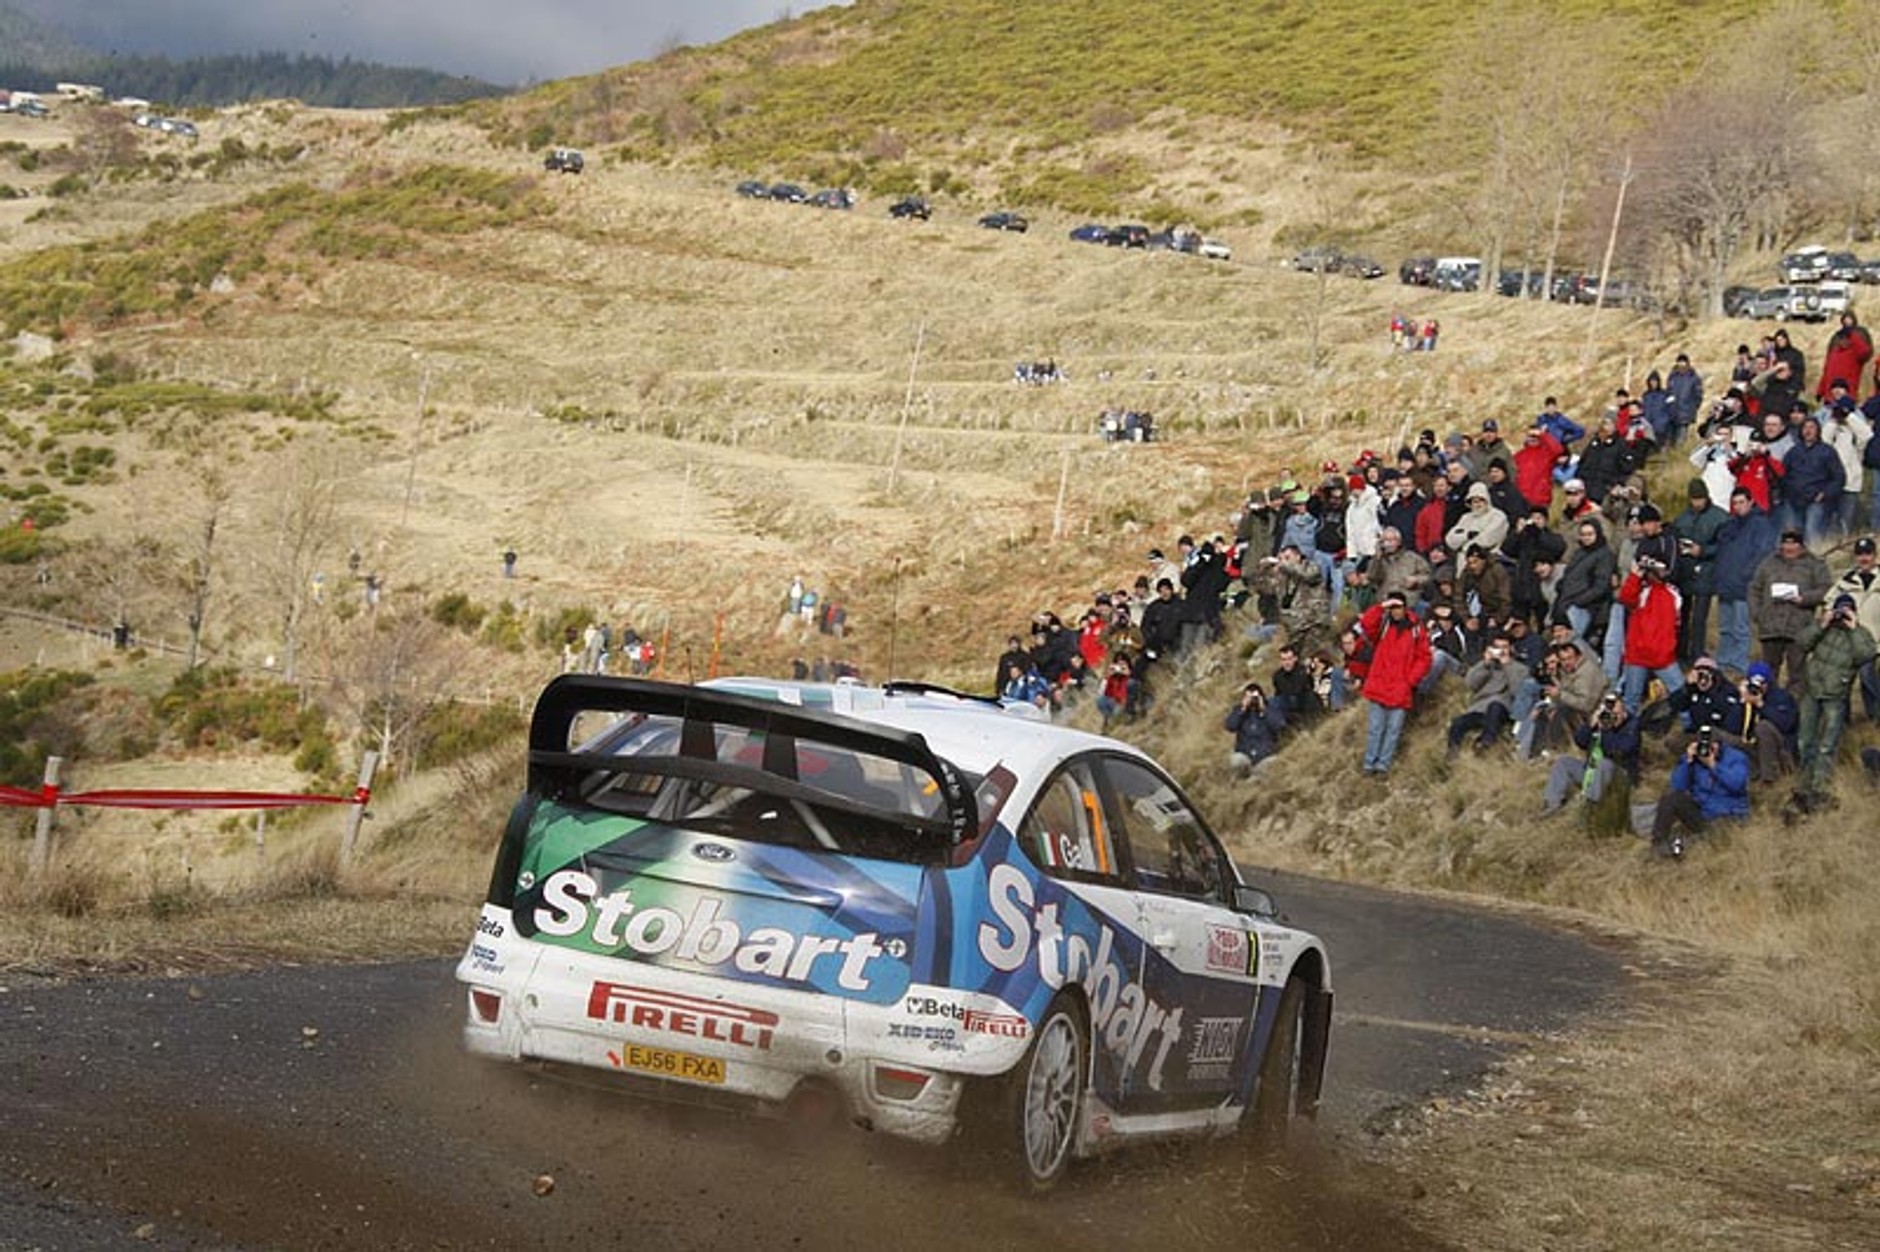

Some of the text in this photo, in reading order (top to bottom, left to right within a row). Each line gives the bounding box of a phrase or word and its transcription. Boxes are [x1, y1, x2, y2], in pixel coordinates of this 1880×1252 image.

[533, 869, 882, 991] Stobart
[978, 863, 1185, 1091] Stobart
[587, 980, 779, 1050] PIRELLI
[925, 999, 965, 1020] Beta
[963, 1010, 1027, 1039] PIRELLI
[629, 1046, 721, 1078] EJ56 FXA
